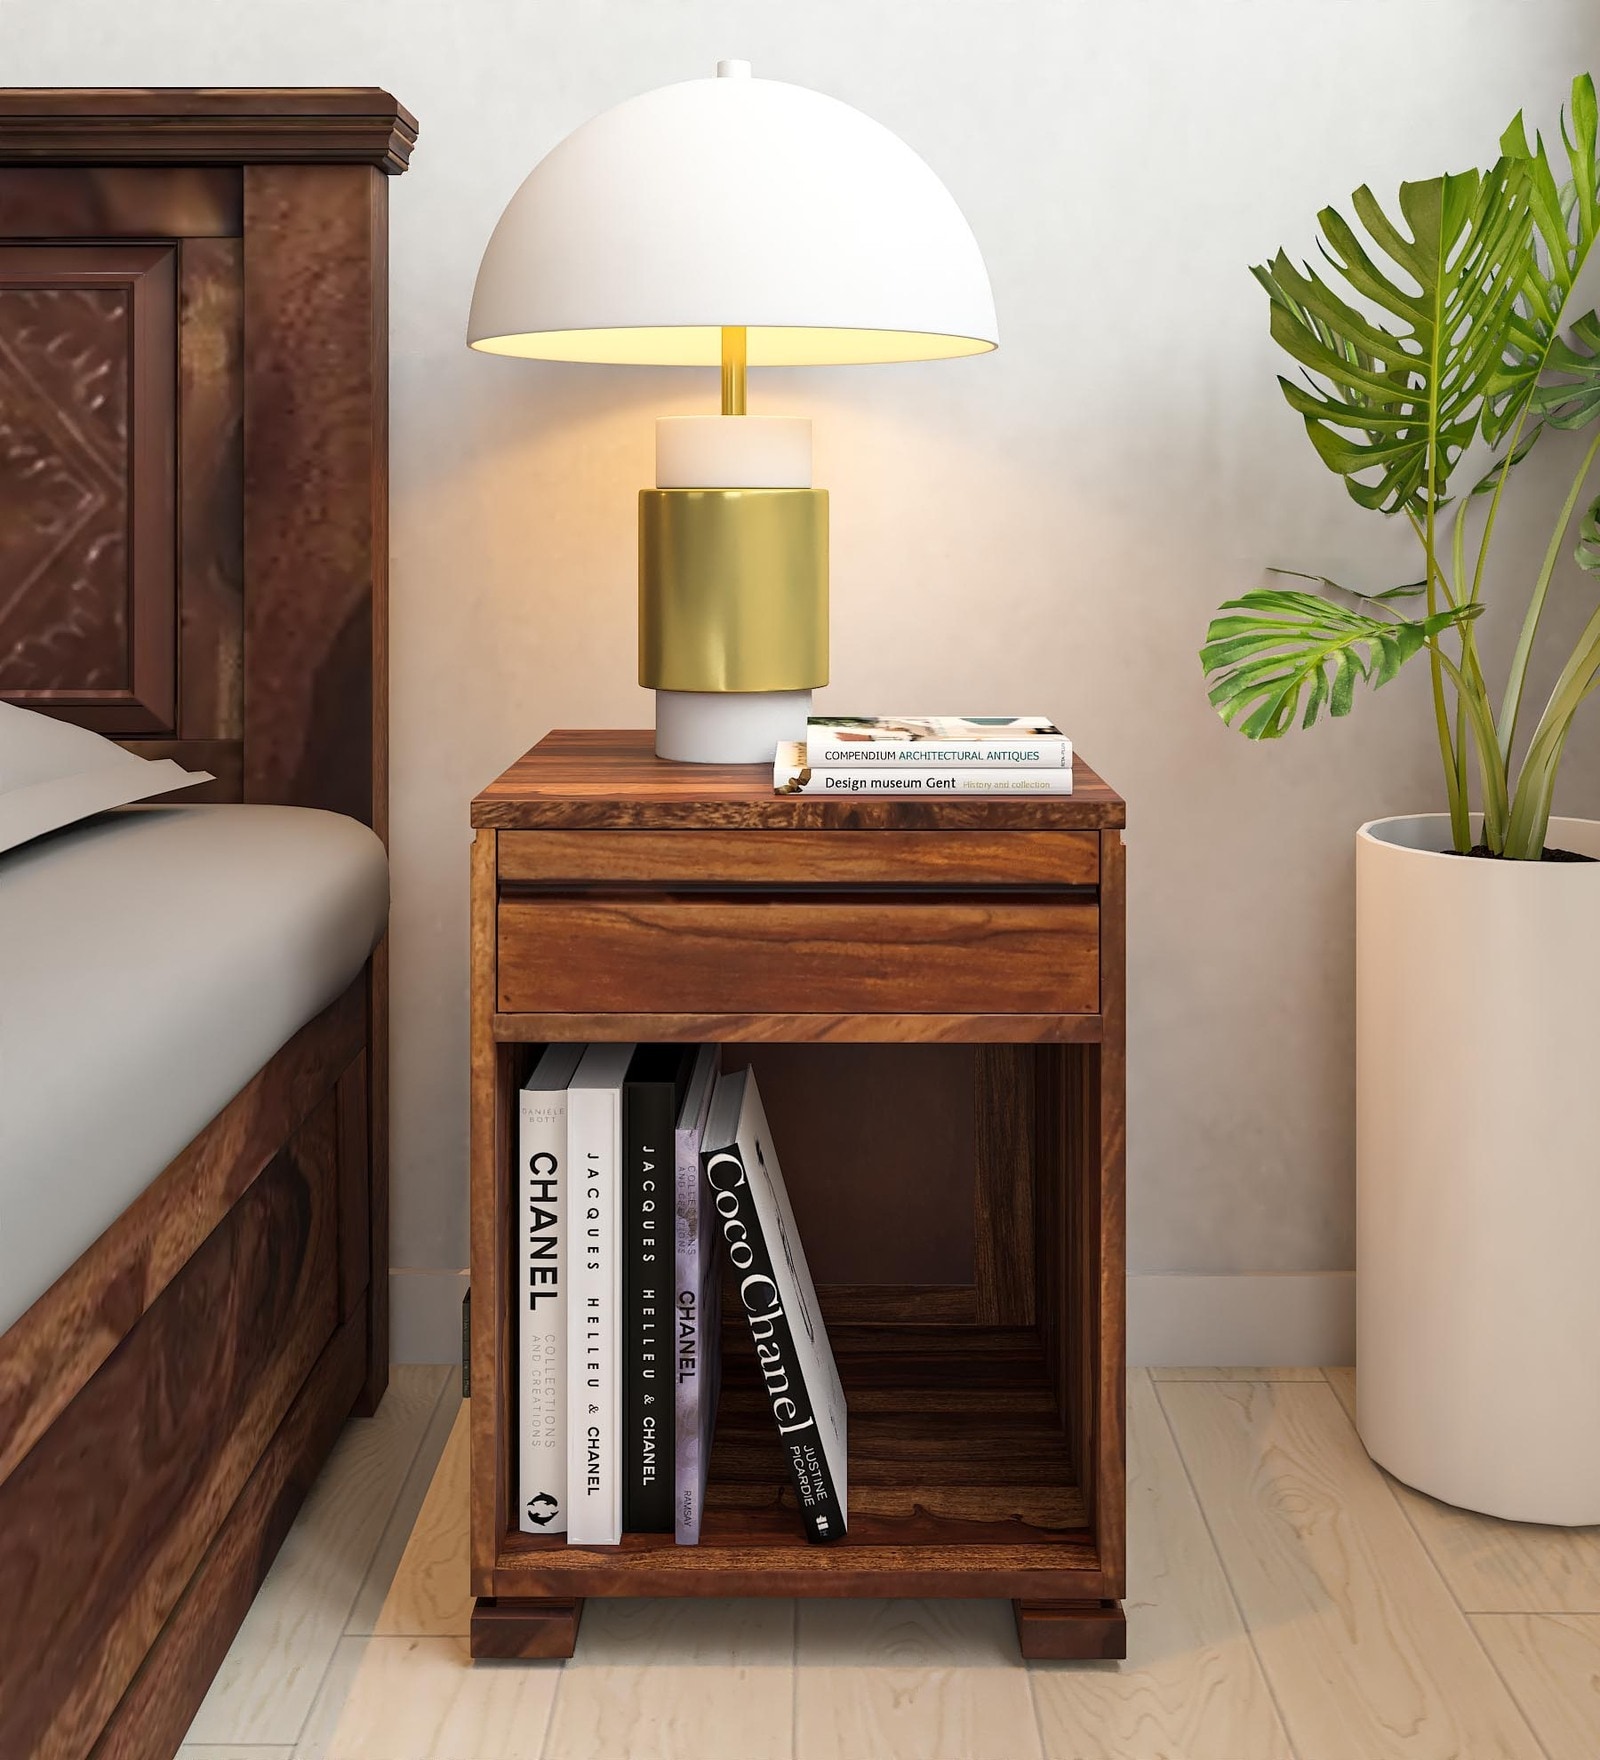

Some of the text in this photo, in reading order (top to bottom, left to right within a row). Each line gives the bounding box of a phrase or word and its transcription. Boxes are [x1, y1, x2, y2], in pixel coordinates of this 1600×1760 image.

[825, 751, 1040, 762] COMPENDIUM ARCHITECTURAL ANTIQUES
[825, 777, 956, 791] Design museum Gent
[963, 780, 1051, 791] History and collection
[529, 1152, 558, 1311] CHANEL
[586, 1153, 600, 1496] JACQUES HELLEU & CHANEL
[642, 1146, 656, 1486] JACQUES HELLEU & CHANEL
[679, 1291, 696, 1384] CHANEL
[707, 1153, 814, 1437] Coco Chanel
[531, 1335, 541, 1447] AND CREATIONS
[544, 1334, 556, 1448] COLLECTIONS
[684, 1490, 692, 1527] RAMSAY
[790, 1445, 815, 1507] PICARDIE
[803, 1445, 828, 1500] JUSTINE
